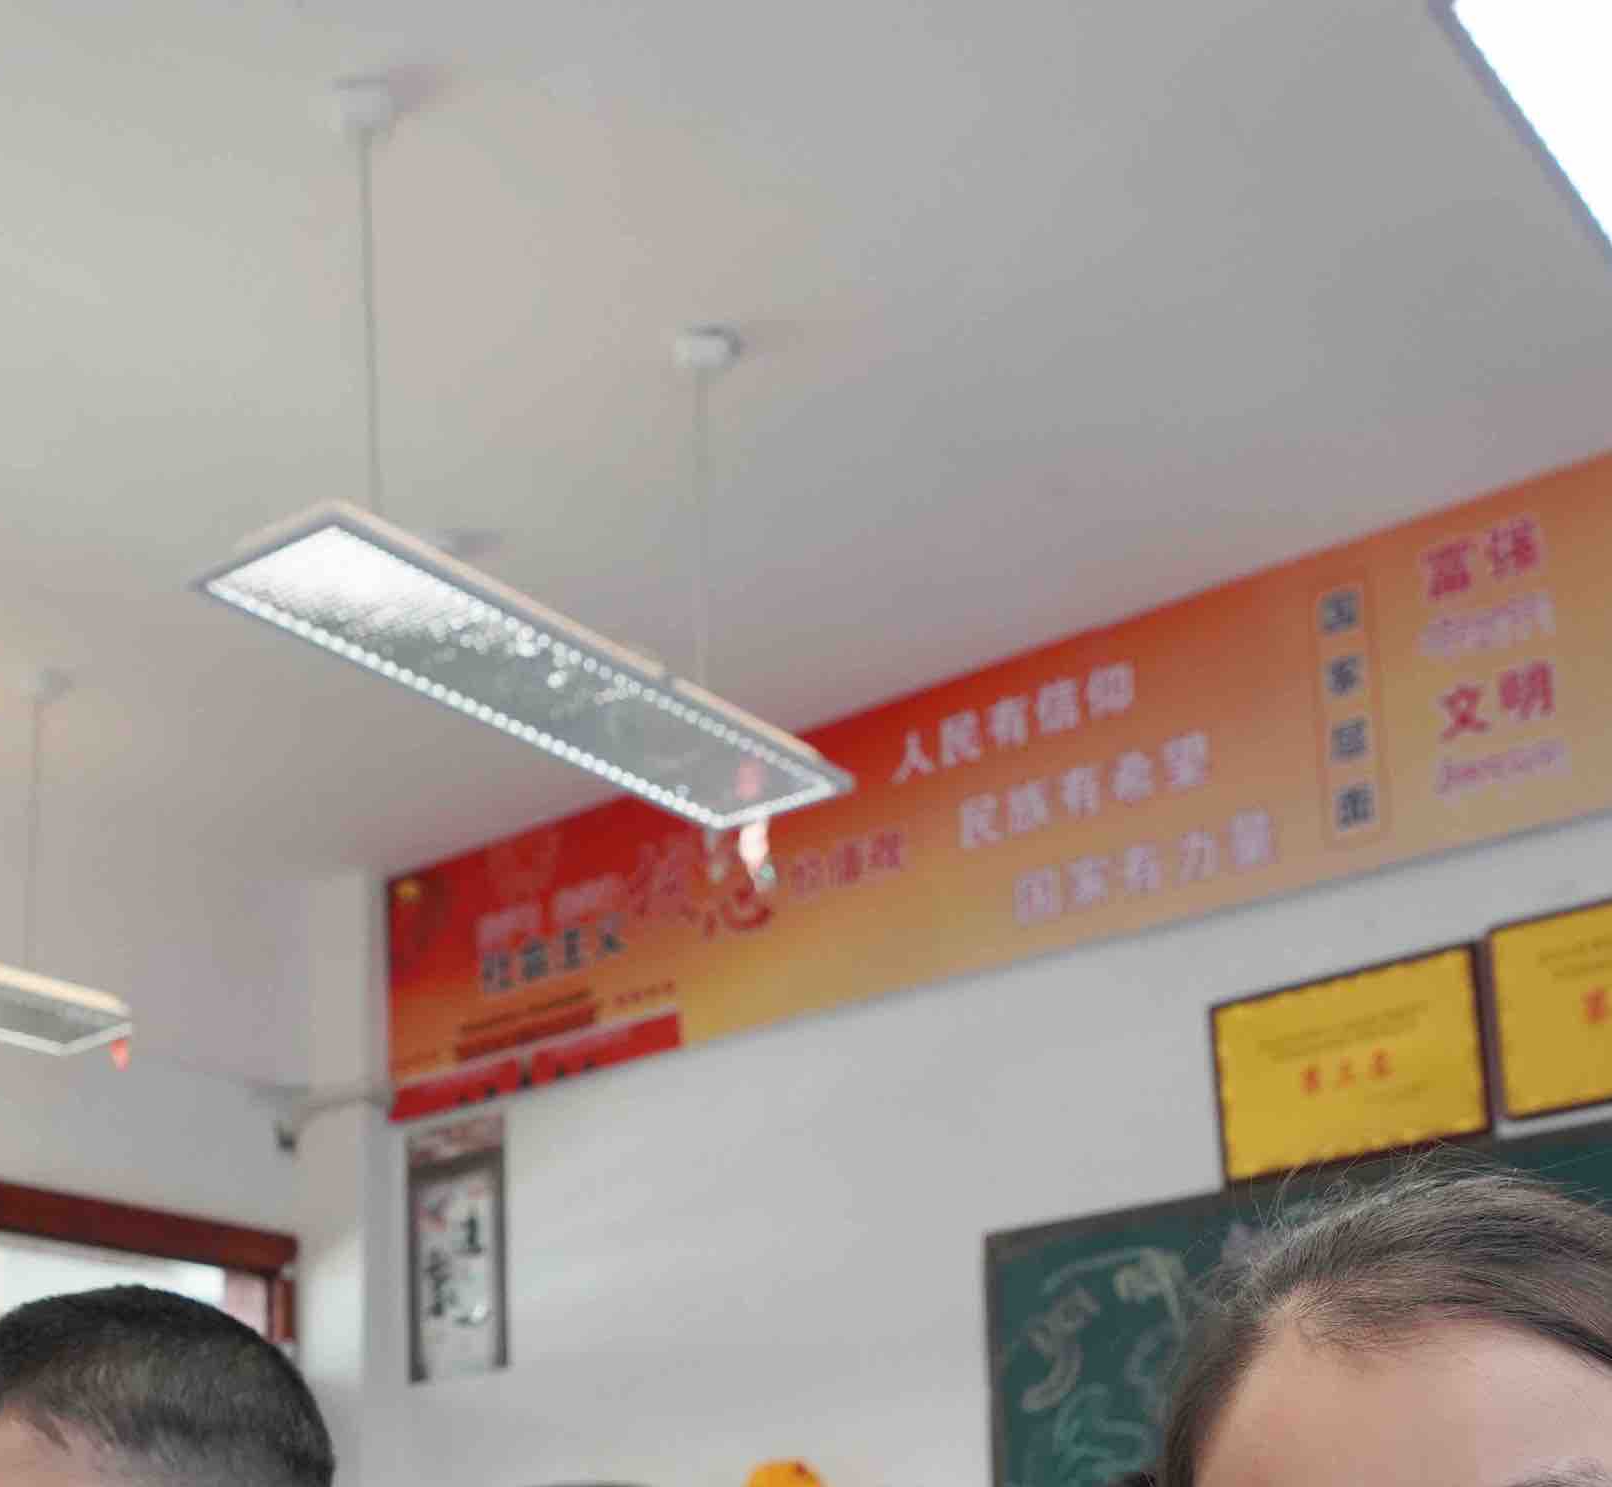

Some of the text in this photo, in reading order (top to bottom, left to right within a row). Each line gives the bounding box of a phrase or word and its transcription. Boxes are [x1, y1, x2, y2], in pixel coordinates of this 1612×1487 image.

[1421, 519, 1540, 602] 富强
[892, 661, 1134, 784] 人民有信仰
[1318, 586, 1378, 831] 国家层面
[1437, 659, 1556, 743] 文明
[957, 729, 1211, 851] 民族有希望
[1013, 807, 1276, 925] 国家有力量
